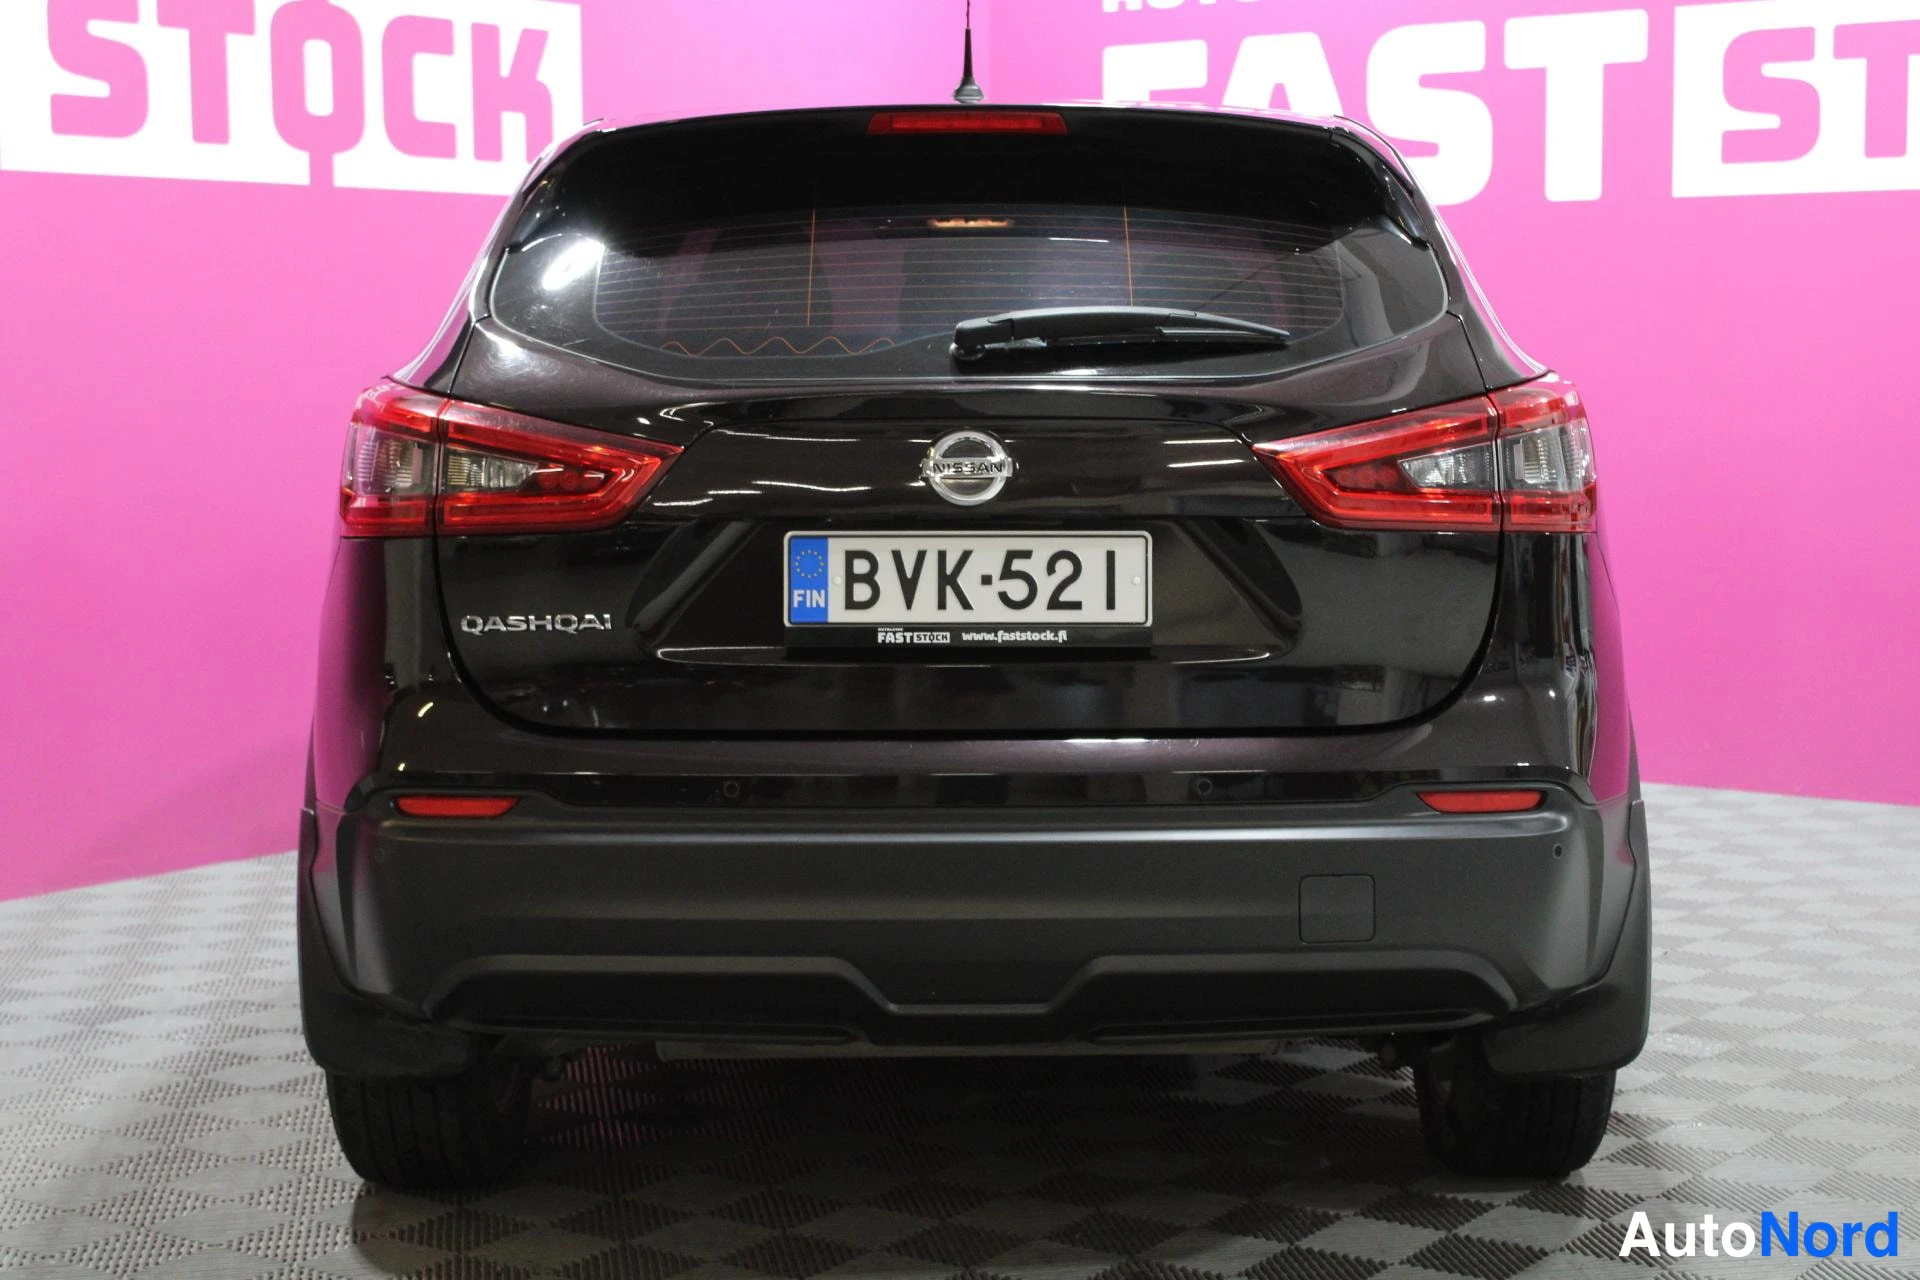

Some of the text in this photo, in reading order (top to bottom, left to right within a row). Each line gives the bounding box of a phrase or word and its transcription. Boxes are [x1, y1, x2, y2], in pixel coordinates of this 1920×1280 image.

[47, 0, 553, 165] STOCK
[933, 462, 1003, 473] NISSAN
[844, 550, 1116, 610] BVK-521
[793, 589, 825, 608] FIN
[460, 614, 612, 636] QASHQAI
[962, 630, 1067, 643] www.faststock.fi
